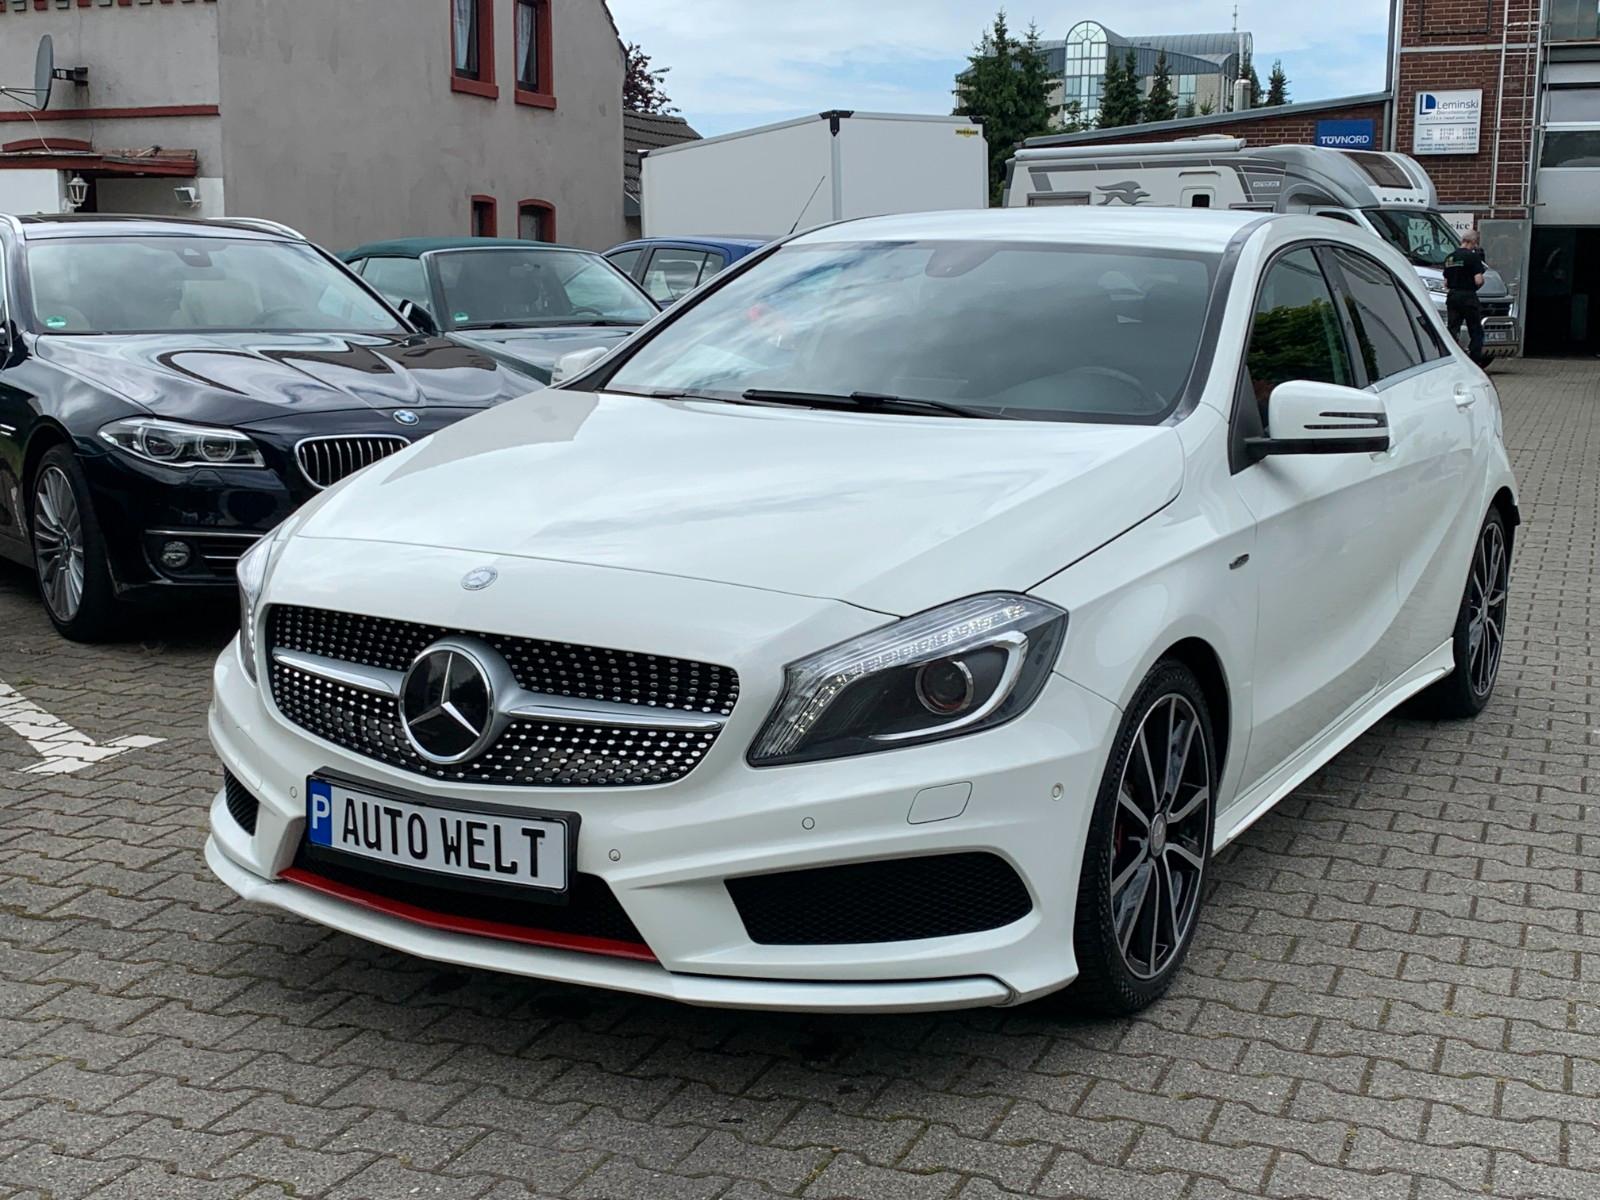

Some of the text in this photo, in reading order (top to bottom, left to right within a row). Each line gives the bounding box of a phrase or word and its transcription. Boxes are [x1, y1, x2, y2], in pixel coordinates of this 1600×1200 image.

[1437, 100, 1479, 109] Leminski
[311, 792, 546, 878] P AUTO WELT
